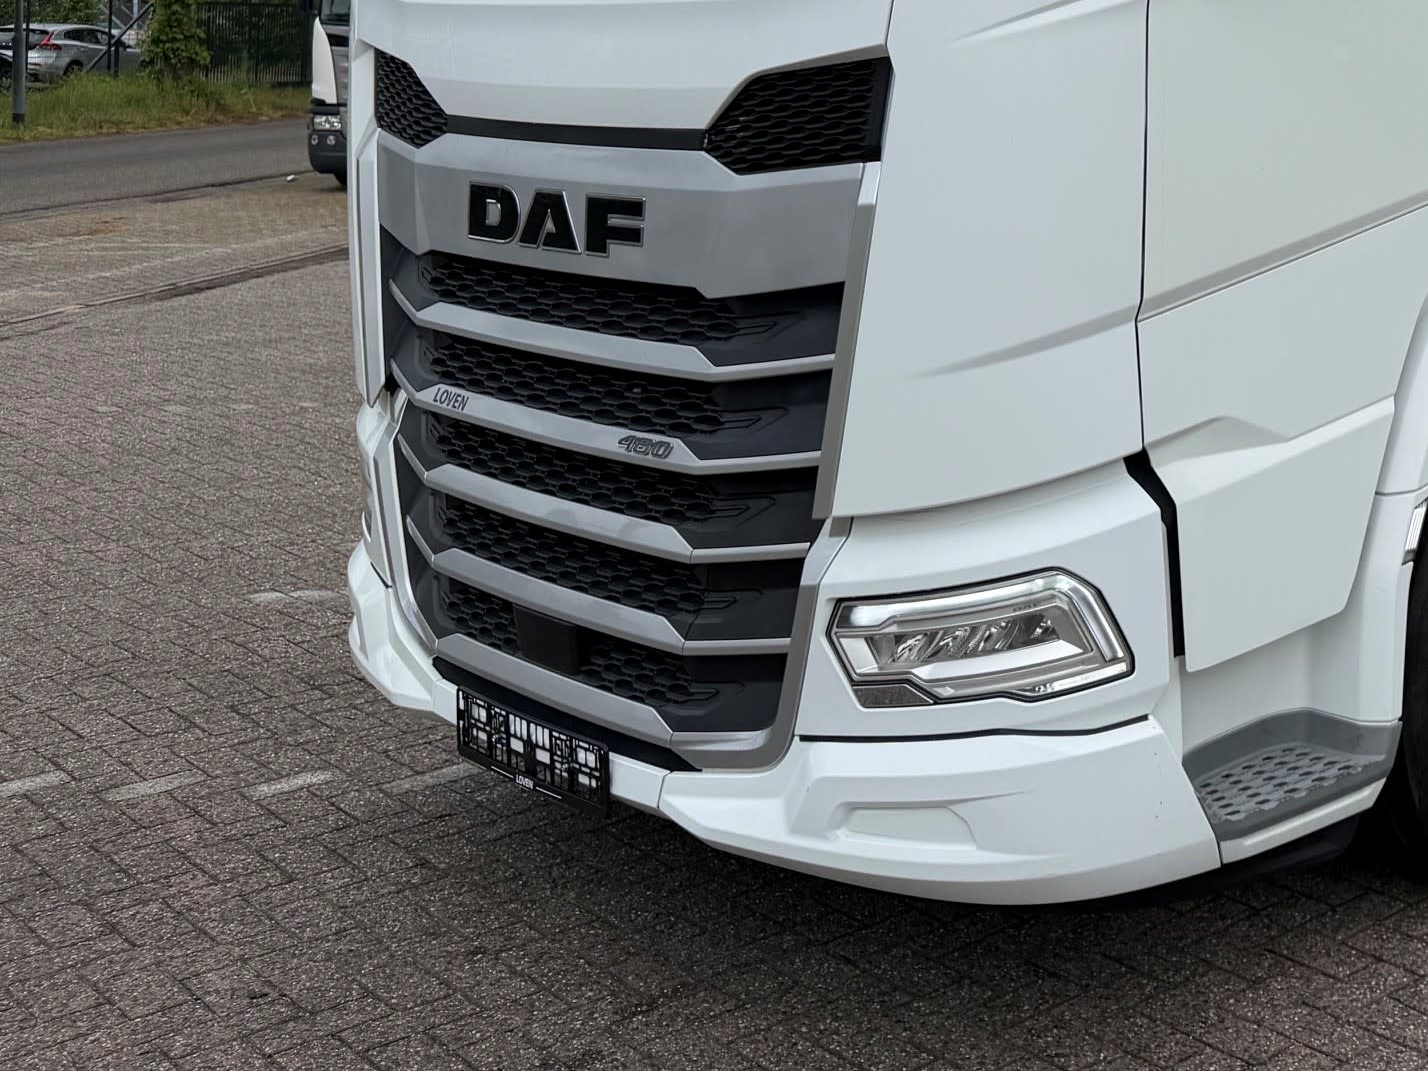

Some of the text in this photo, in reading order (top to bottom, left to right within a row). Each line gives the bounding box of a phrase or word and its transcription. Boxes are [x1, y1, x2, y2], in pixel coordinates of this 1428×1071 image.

[467, 180, 646, 258] DAF
[432, 386, 470, 412] LOVEN
[515, 773, 534, 790] LOVEN
